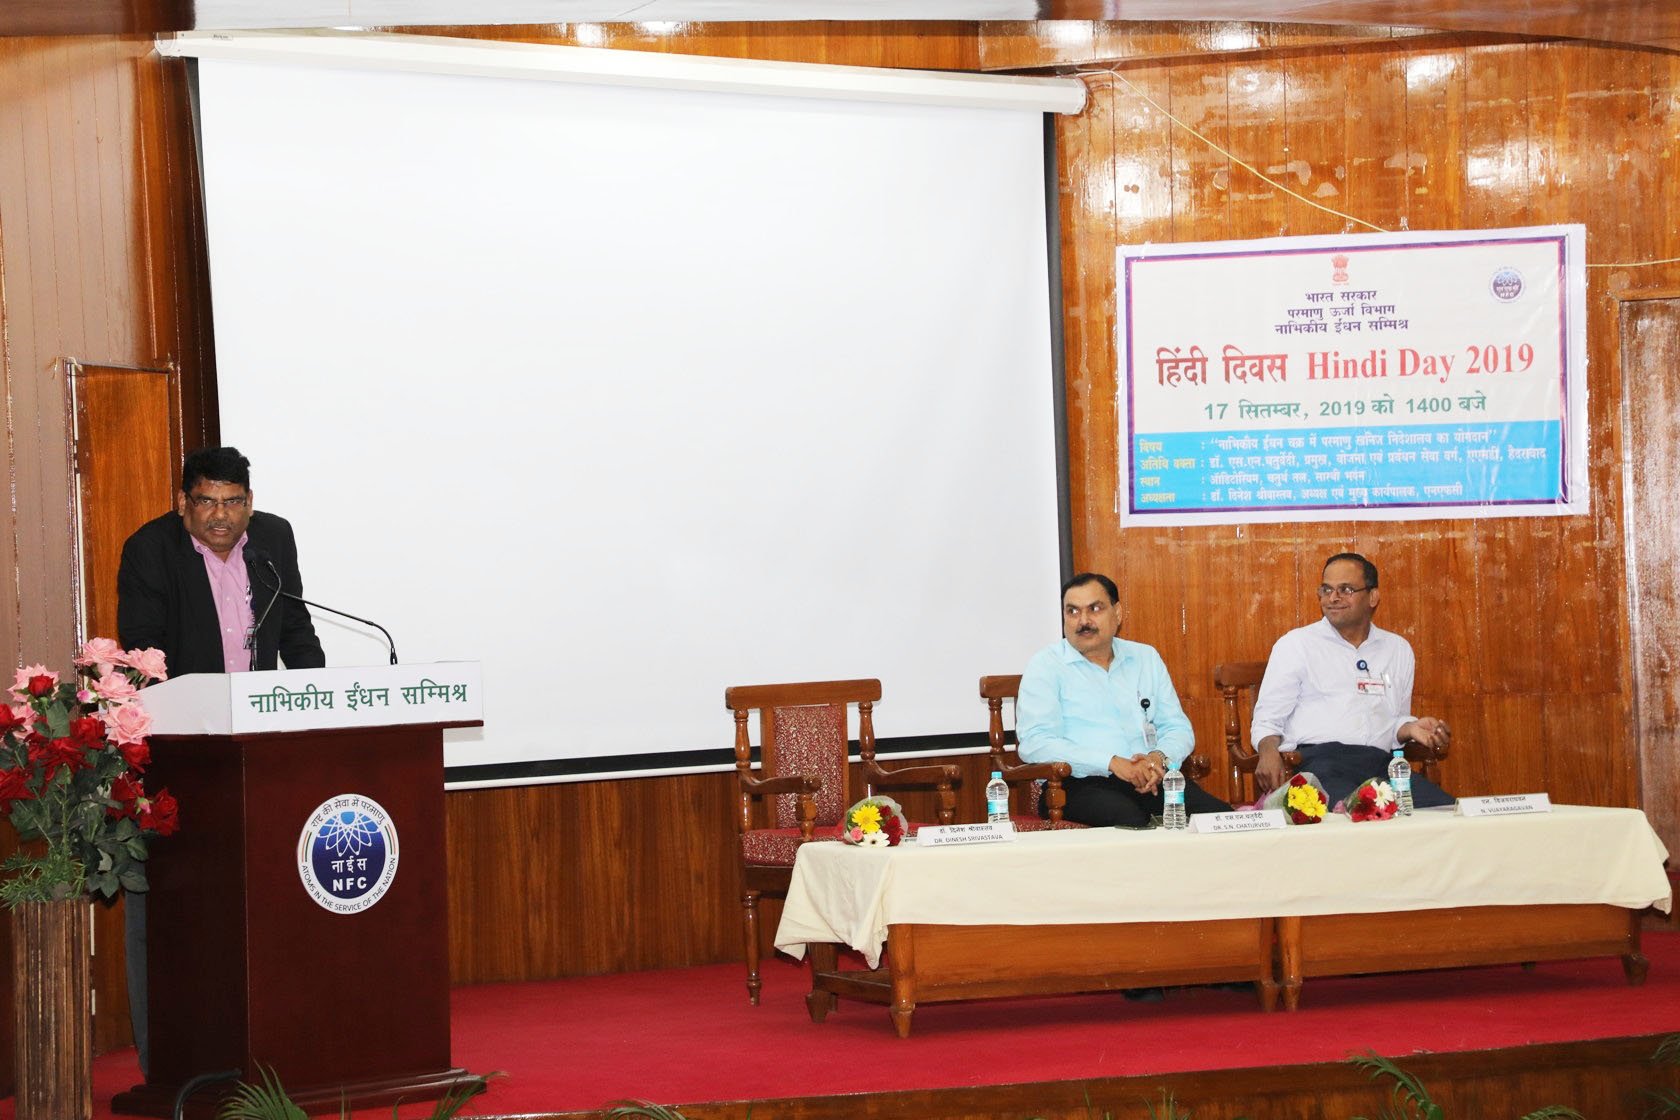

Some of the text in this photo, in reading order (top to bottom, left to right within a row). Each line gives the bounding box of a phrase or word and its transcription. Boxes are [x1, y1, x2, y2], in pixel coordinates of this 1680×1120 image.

[1305, 290, 1377, 303] भारत सरकार
[1287, 303, 1396, 320] परमाणु ऊर्जा विभाग
[1274, 320, 1328, 335] नाभिकीय
[1368, 317, 1409, 331] सम्मिश्र
[1156, 343, 1534, 388] हिंदी दिवस Hindi Day 2019
[1204, 403, 1228, 420] 17
[1319, 400, 1365, 417] 2019
[1371, 393, 1394, 415] को
[1405, 398, 1451, 414] 1400
[1458, 390, 1487, 412] बजे
[1309, 432, 1317, 448] में
[1321, 435, 1352, 450] परमाणु
[1436, 432, 1449, 444] का
[249, 678, 467, 712] नाभिकीय ईंधन सम्मिश्र
[302, 857, 396, 912] ATOMS IN THE SERVICE OF THE NATION
[332, 876, 368, 892] NFC
